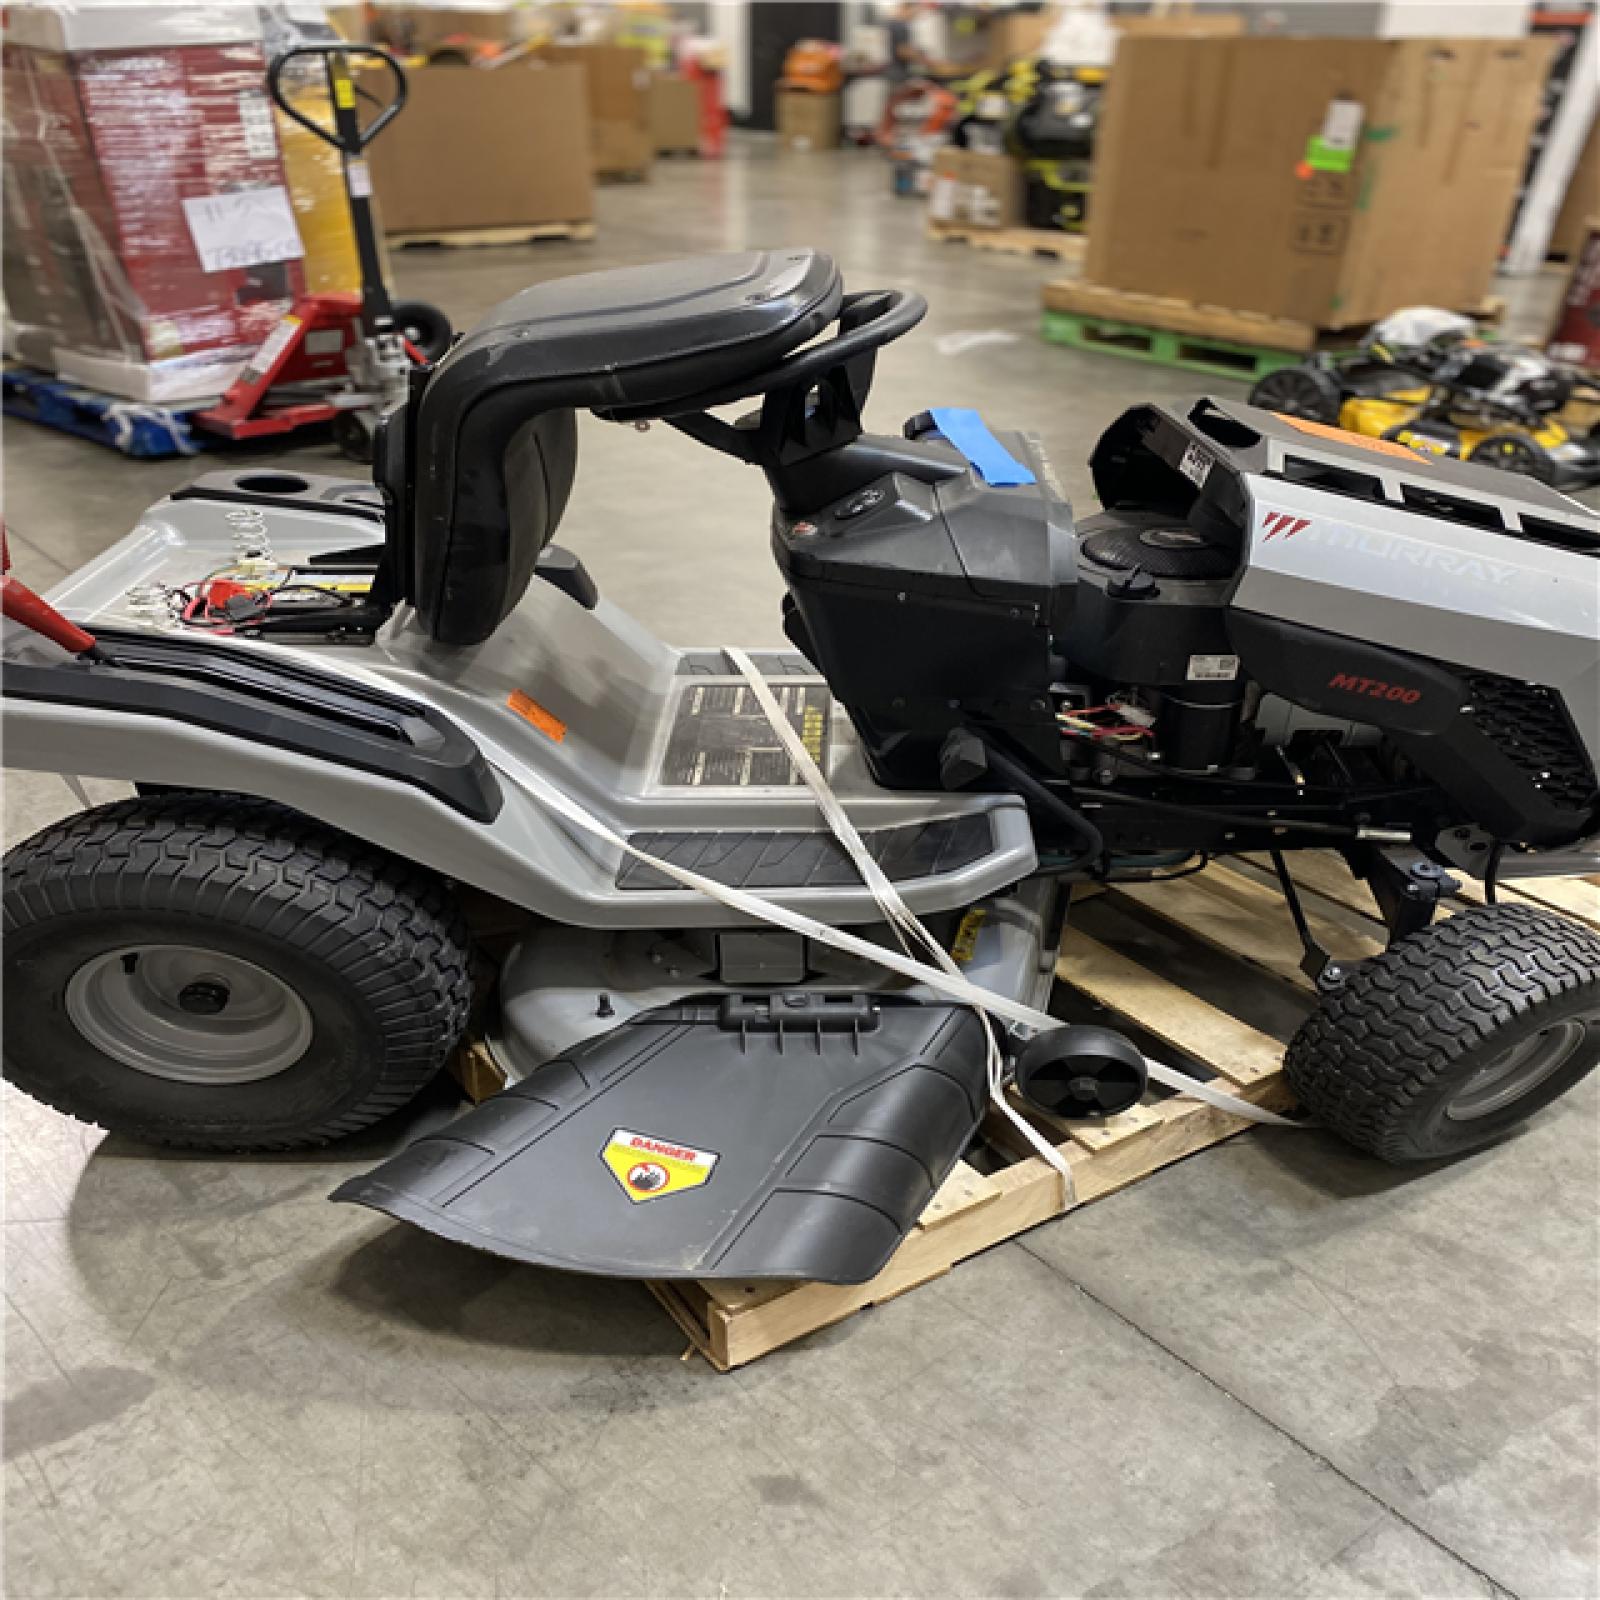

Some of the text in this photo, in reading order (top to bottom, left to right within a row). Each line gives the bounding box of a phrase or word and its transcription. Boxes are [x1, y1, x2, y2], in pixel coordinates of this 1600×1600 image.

[1308, 520, 1520, 584] MURRAY
[1328, 672, 1421, 704] MT200
[630, 1137, 696, 1161] DANGER
